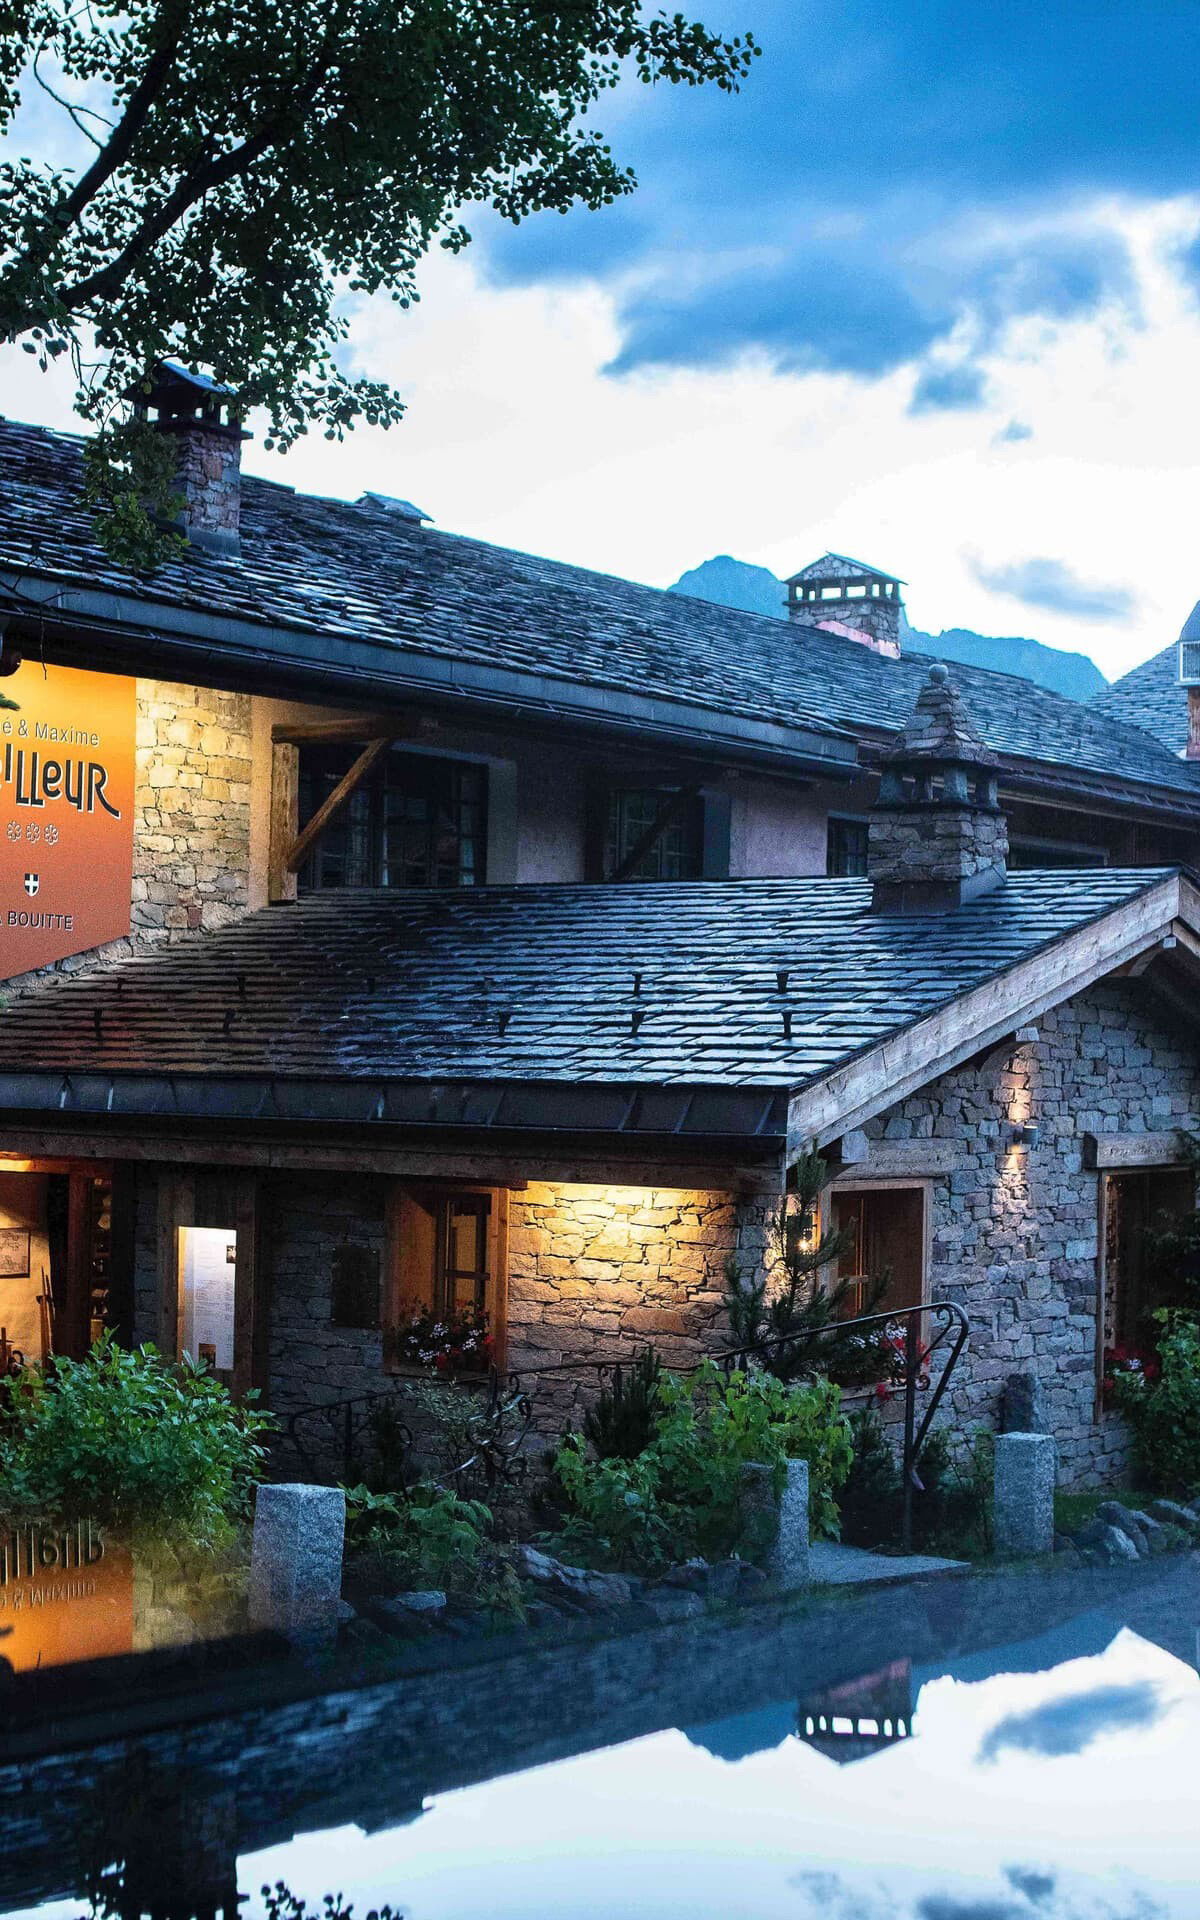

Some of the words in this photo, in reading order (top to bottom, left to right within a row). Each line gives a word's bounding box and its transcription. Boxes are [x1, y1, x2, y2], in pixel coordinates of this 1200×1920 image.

[18, 719, 28, 737] &
[35, 722, 100, 747] Maxime
[7, 910, 74, 931] BOUITTE
